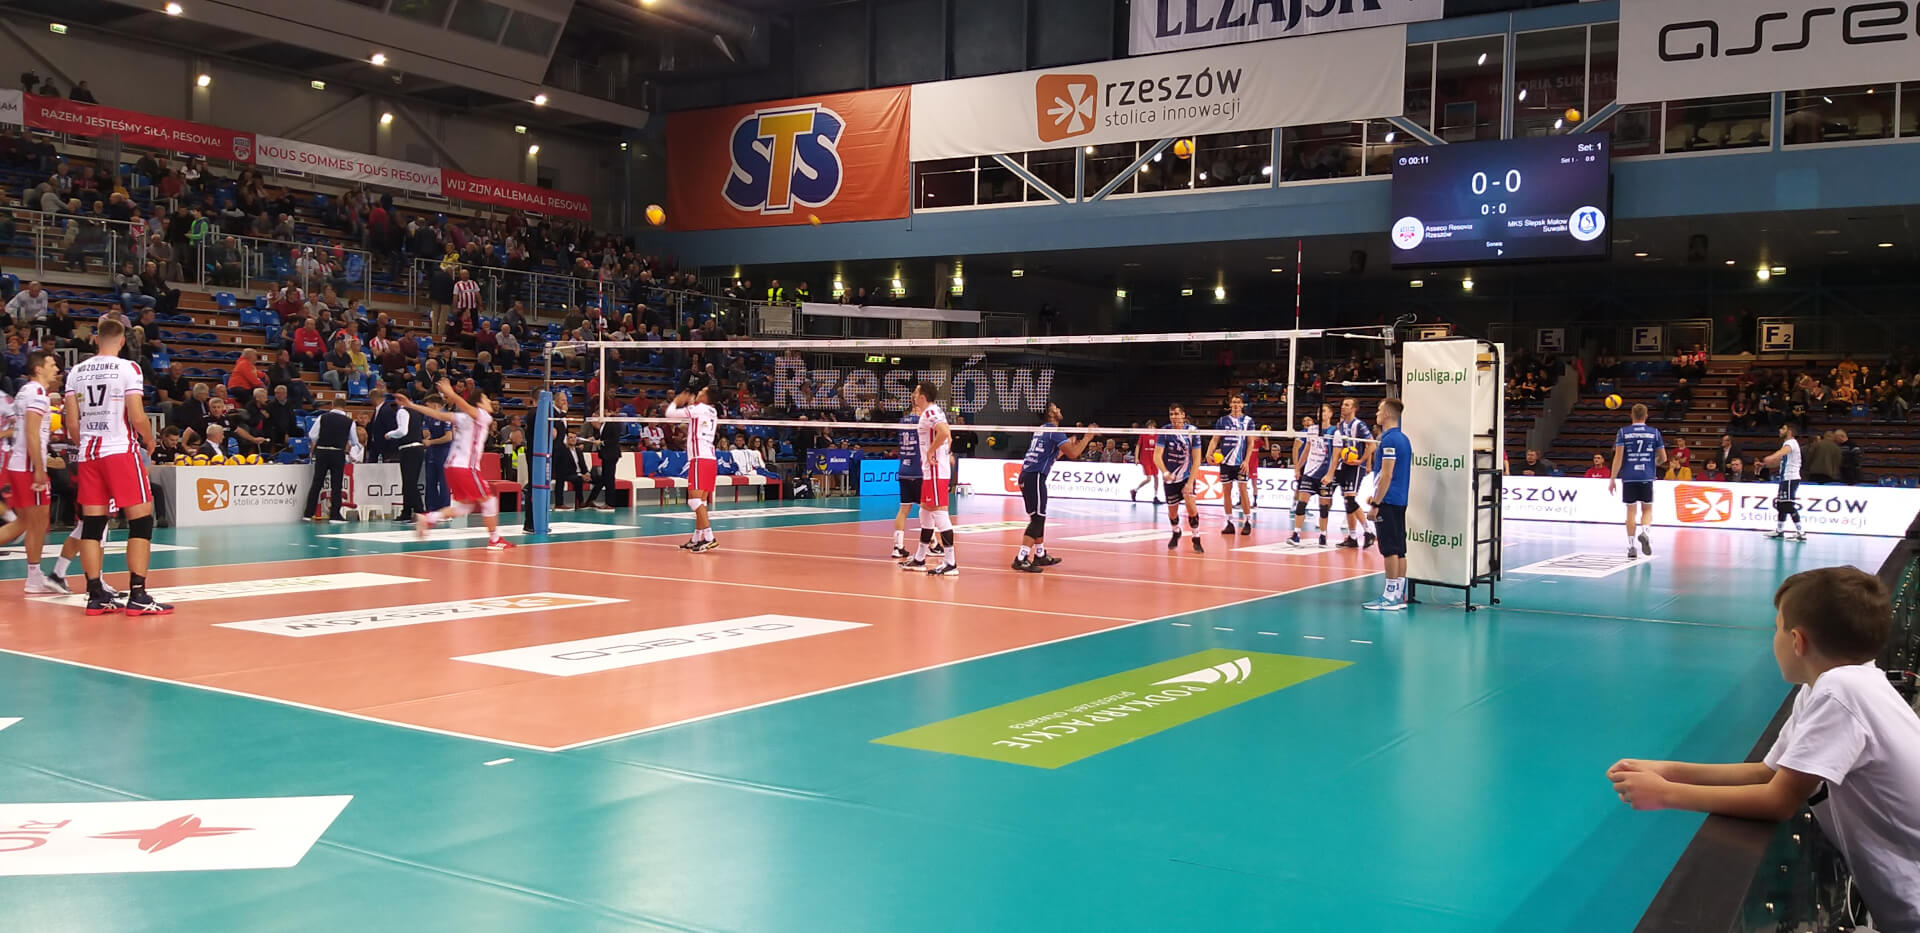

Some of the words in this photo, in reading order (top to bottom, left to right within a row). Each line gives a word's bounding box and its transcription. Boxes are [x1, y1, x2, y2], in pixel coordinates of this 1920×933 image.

[1659, 1, 1920, 62] asse
[1105, 67, 1242, 107] rzeszów
[41, 108, 82, 124] RAZEM
[85, 116, 142, 133] JESTEŚMY
[172, 130, 221, 148] RESOVIA!
[1105, 109, 1156, 127] stolica
[1163, 98, 1241, 121] innowacji
[259, 144, 296, 161] NOUS
[300, 152, 354, 172] SOMMES
[357, 162, 388, 178] TOUS
[391, 168, 440, 186] RESOVIA
[721, 103, 846, 215] STS
[1408, 156, 1429, 165] 00:11
[447, 178, 465, 191] WIJ
[468, 182, 492, 196] ZIJN
[493, 187, 546, 206] ALLEMAAL
[548, 197, 588, 212] RESOVIA
[774, 353, 1056, 413] Rzeszów
[1407, 368, 1467, 385] plusliga.pl
[87, 384, 107, 407] 17
[1051, 470, 1121, 485] zeszów
[1412, 453, 1465, 471] lusliga.pl
[233, 481, 298, 497] rzeszów
[552, 623, 794, 661] asseco
[992, 685, 1208, 749] PODKARPACKIE
